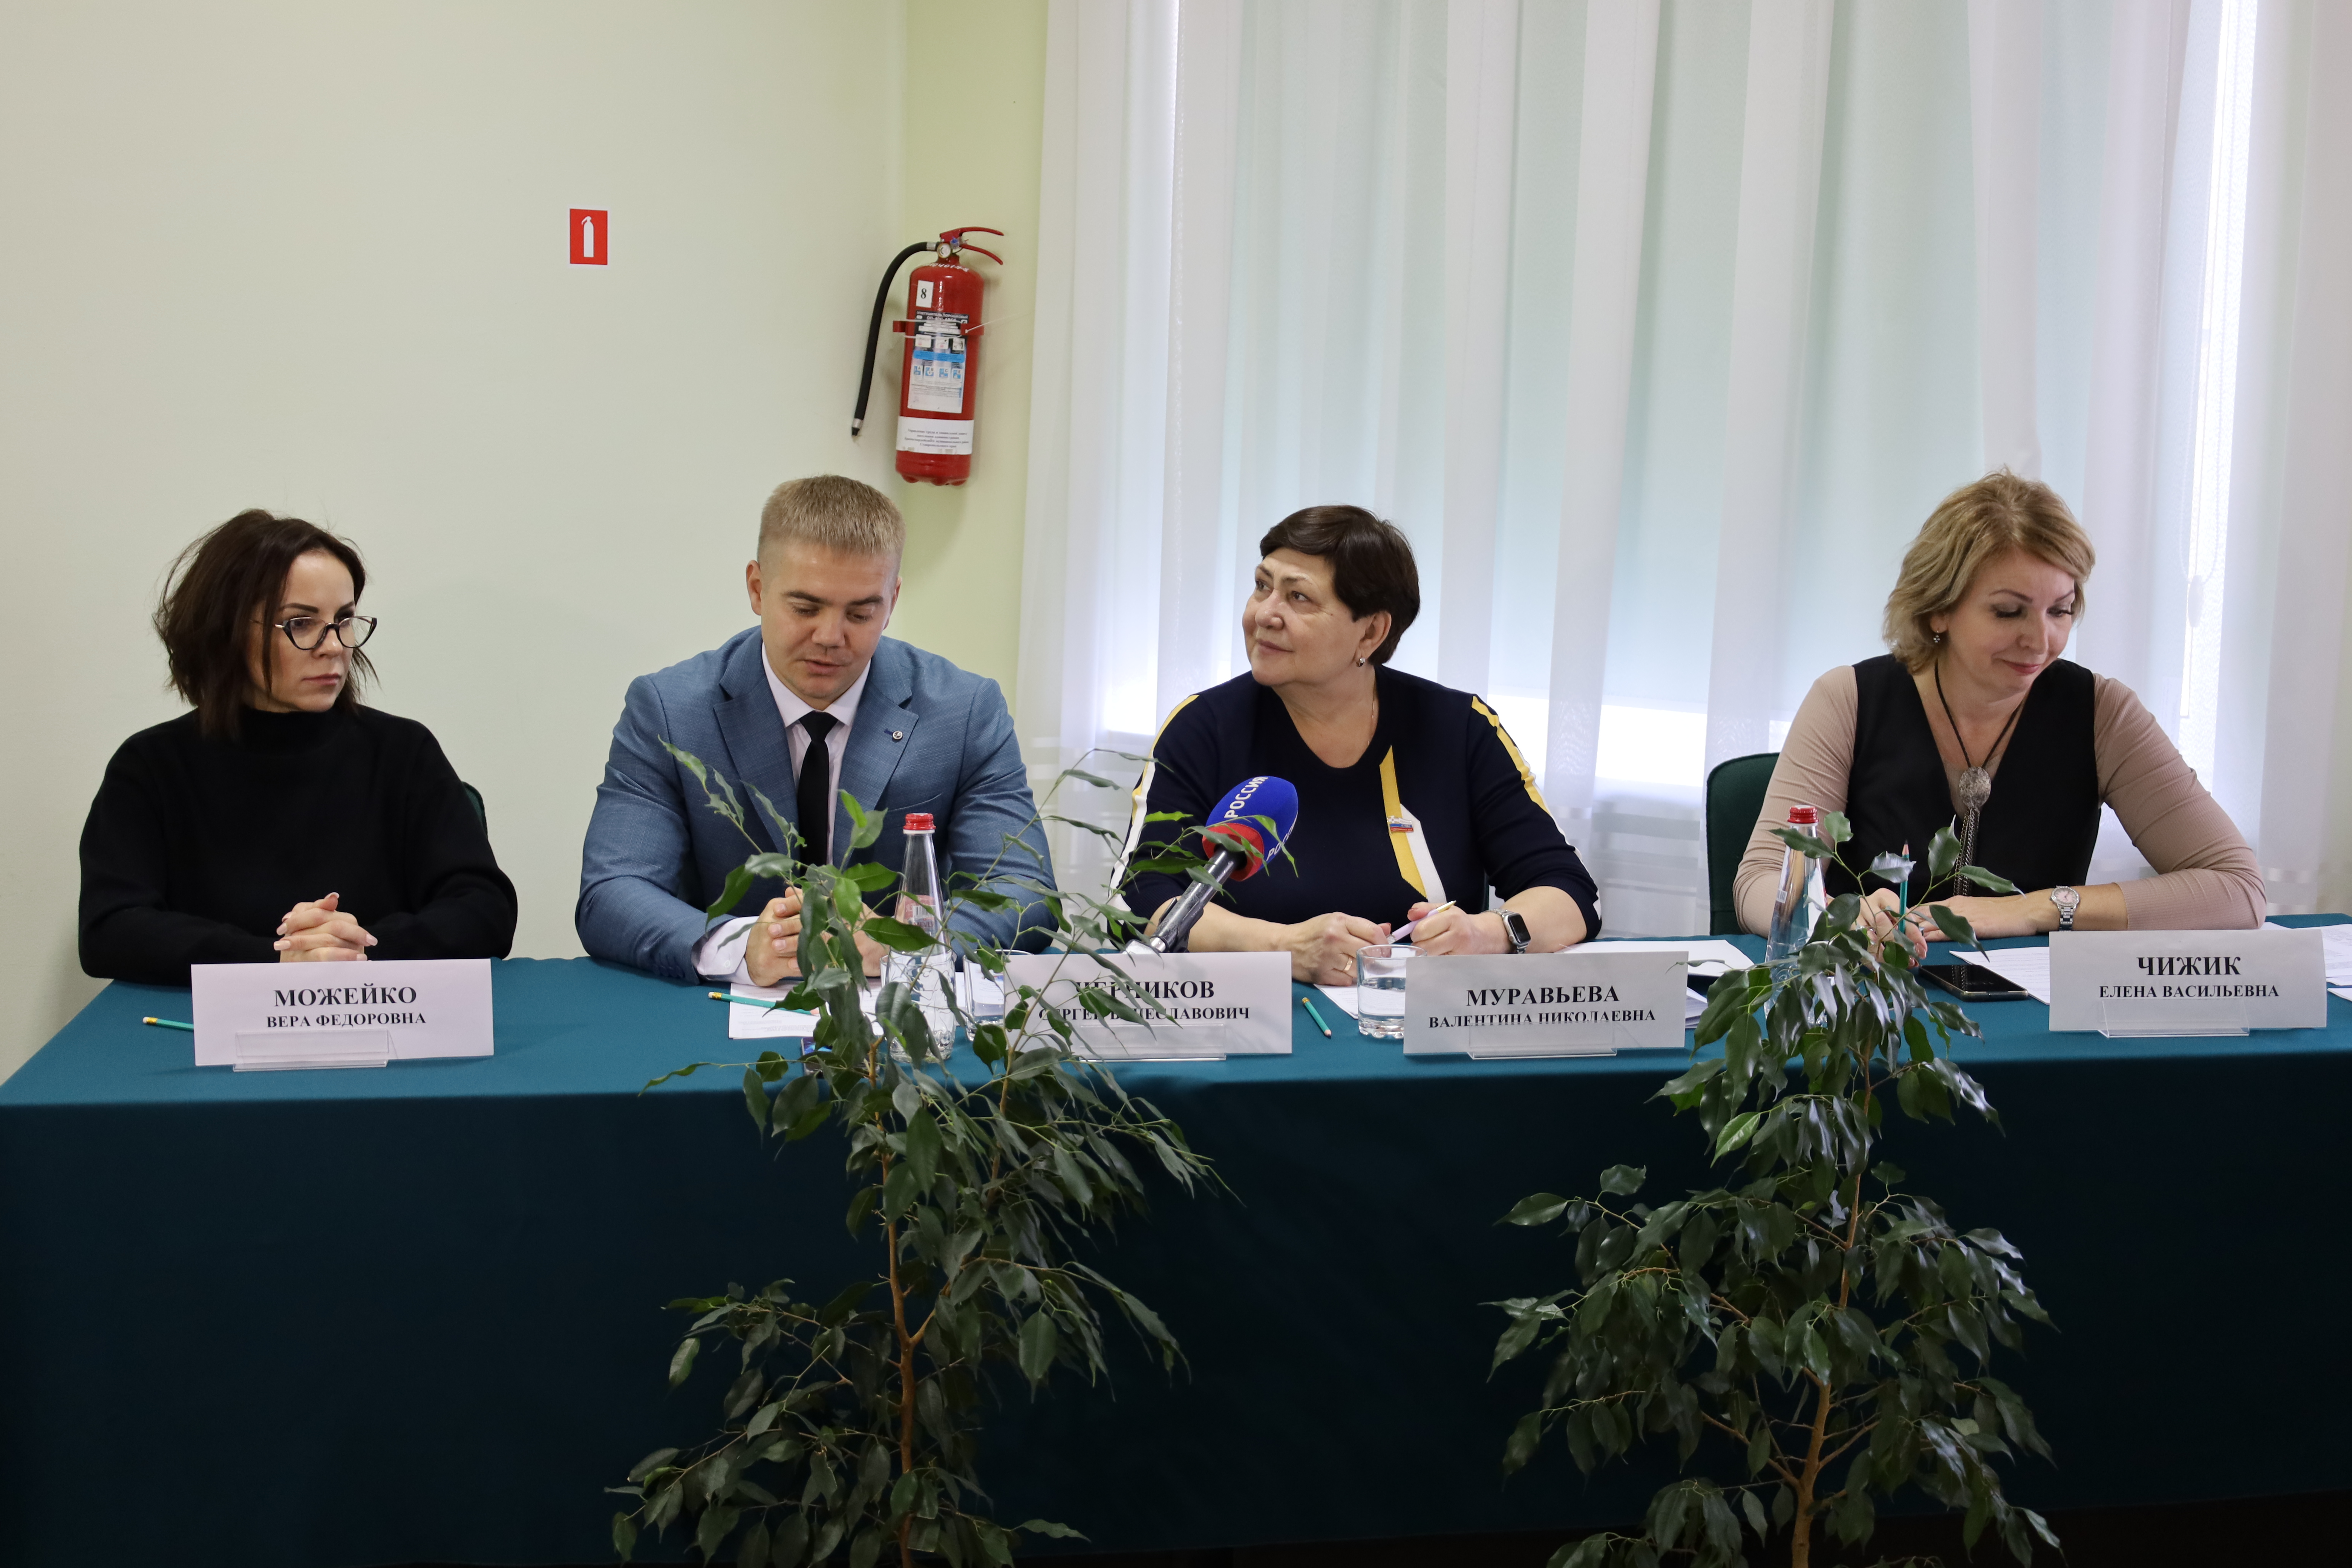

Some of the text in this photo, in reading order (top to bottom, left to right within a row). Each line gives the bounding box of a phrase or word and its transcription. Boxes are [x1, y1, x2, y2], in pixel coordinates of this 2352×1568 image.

[920, 288, 927, 299] 8
[1223, 776, 1269, 818] РОССИЯ
[1266, 810, 1298, 862] РОСС
[2136, 957, 2242, 976] ЧИЖИК
[274, 983, 417, 1006] МОЖЕЙКО
[1466, 985, 1620, 1006] МУРАВЬЕВА
[2099, 985, 2280, 998] ЕЛЕНА ВАСИЛЬЕВНА
[267, 1012, 426, 1028] ВЕРА ФЕДОРОВНА
[1039, 1008, 1250, 1020] СРГЕ ЕСЛАВОВИЧ
[1429, 1009, 1656, 1028] ВАЛЕНТИНА НИКОЛАЕВНА
